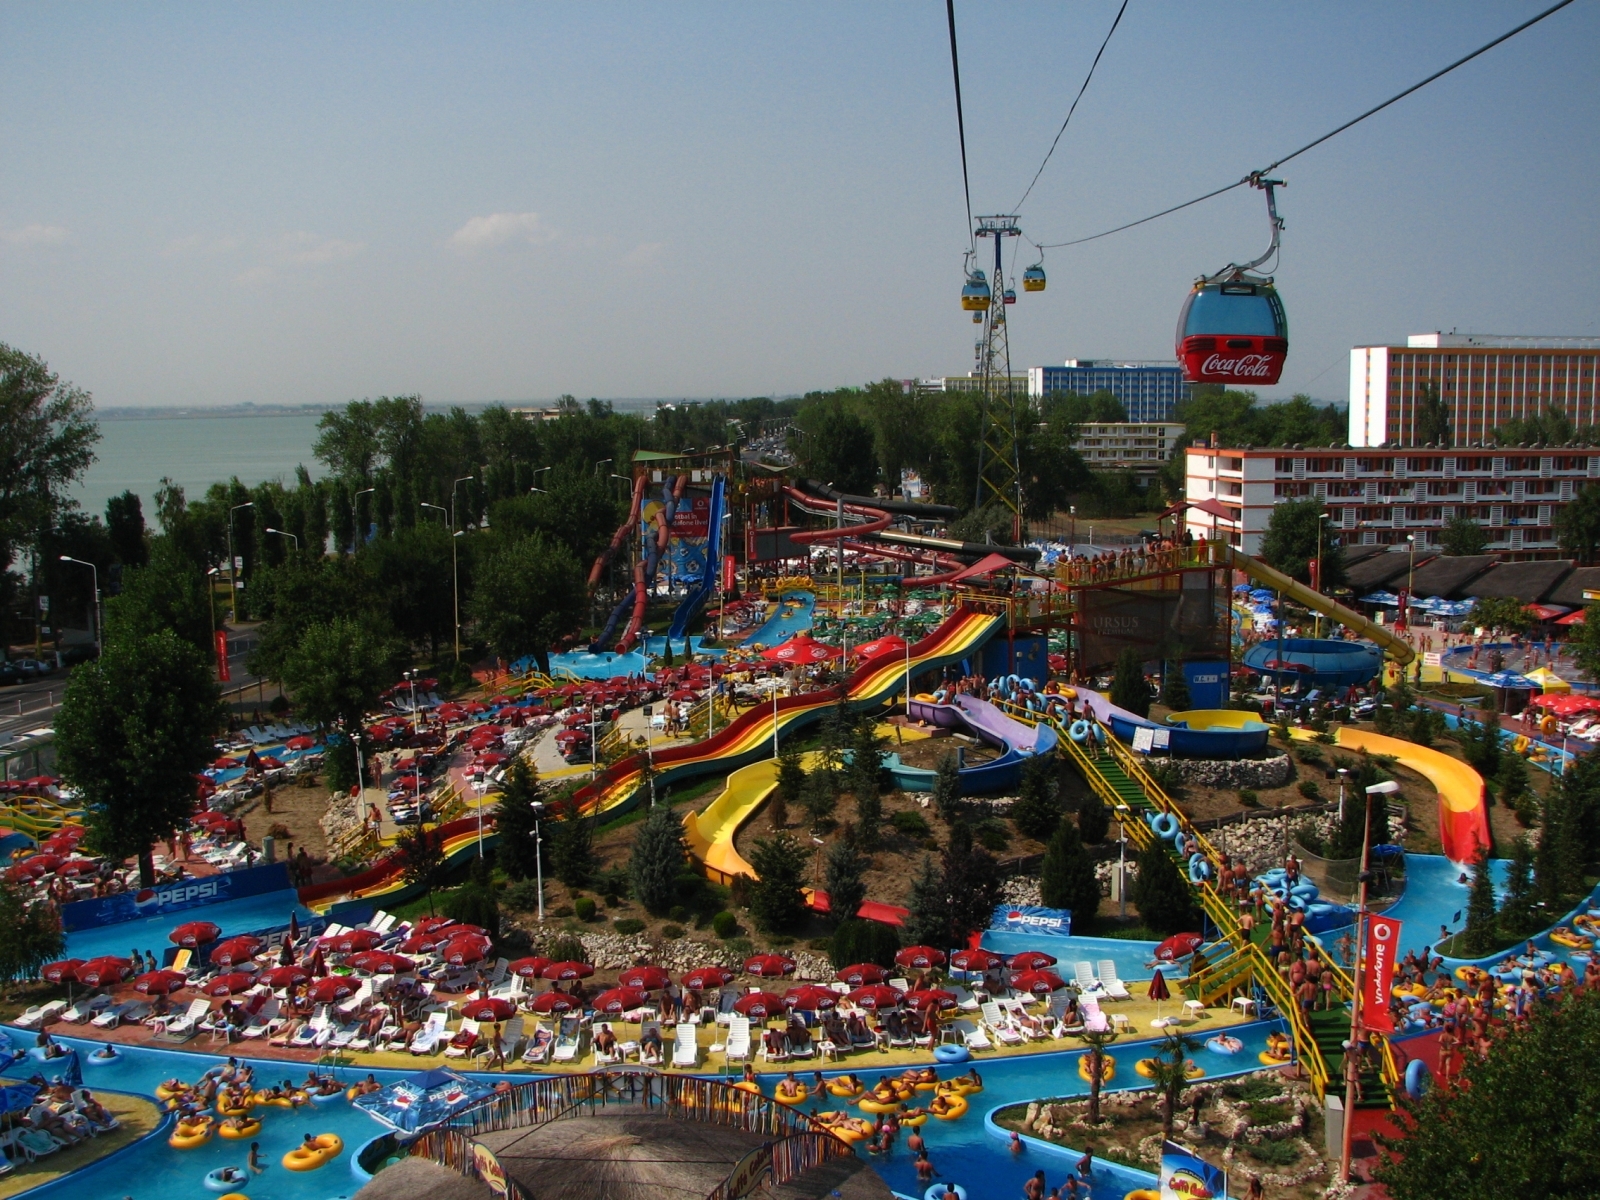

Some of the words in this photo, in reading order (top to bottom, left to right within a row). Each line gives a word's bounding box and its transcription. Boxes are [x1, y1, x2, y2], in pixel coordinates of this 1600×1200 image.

[1093, 616, 1139, 628] URSUS
[157, 881, 218, 906] PEPSI
[1020, 915, 1062, 928] PEPSI
[392, 1085, 419, 1102] PEPSI
[428, 1084, 463, 1102] PEPSI
